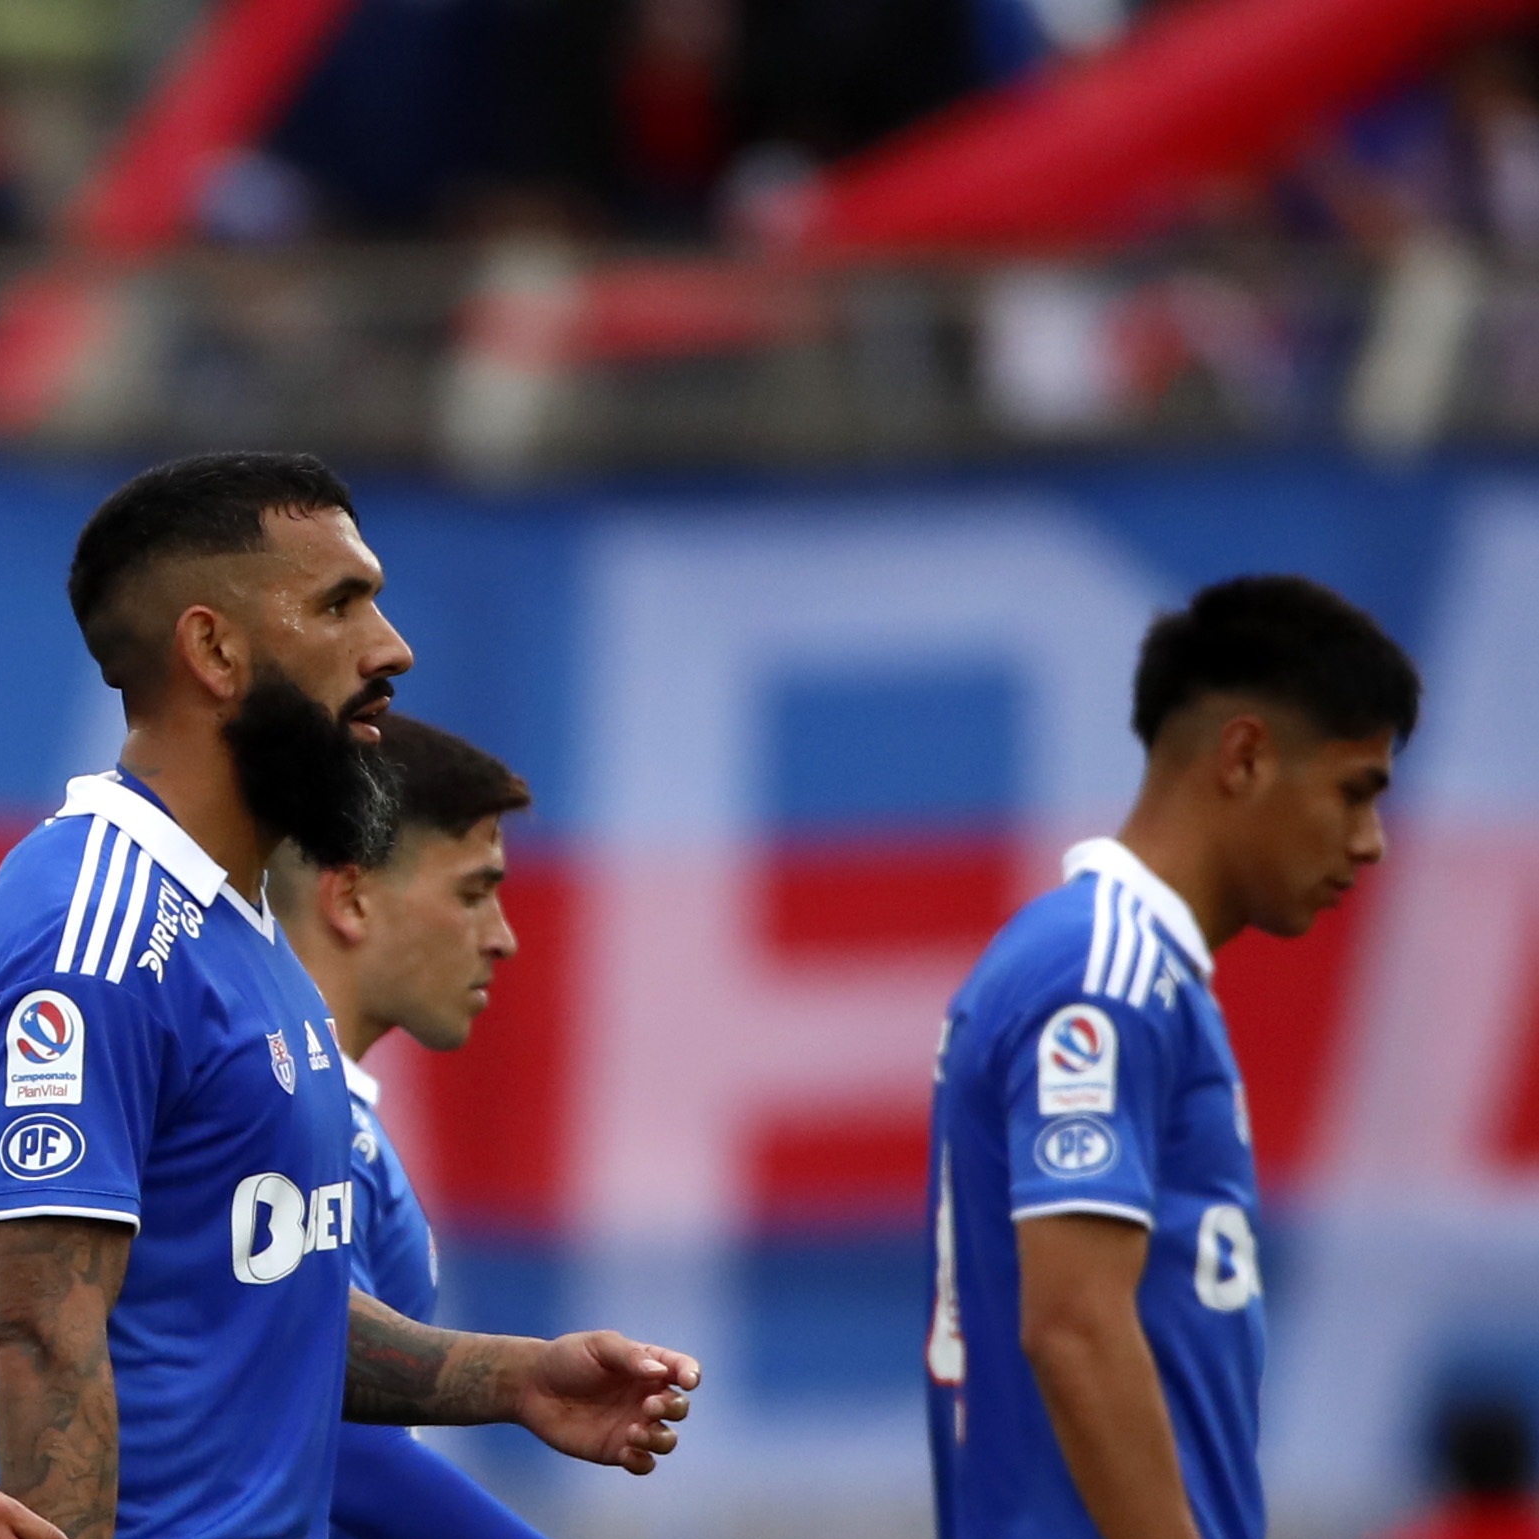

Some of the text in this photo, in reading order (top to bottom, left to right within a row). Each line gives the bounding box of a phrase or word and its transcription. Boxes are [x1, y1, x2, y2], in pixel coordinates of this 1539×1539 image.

[181, 900, 204, 939] GO
[11, 1071, 77, 1082] Campeonato
[17, 1084, 68, 1098] PlanVital
[18, 1127, 61, 1167] PF
